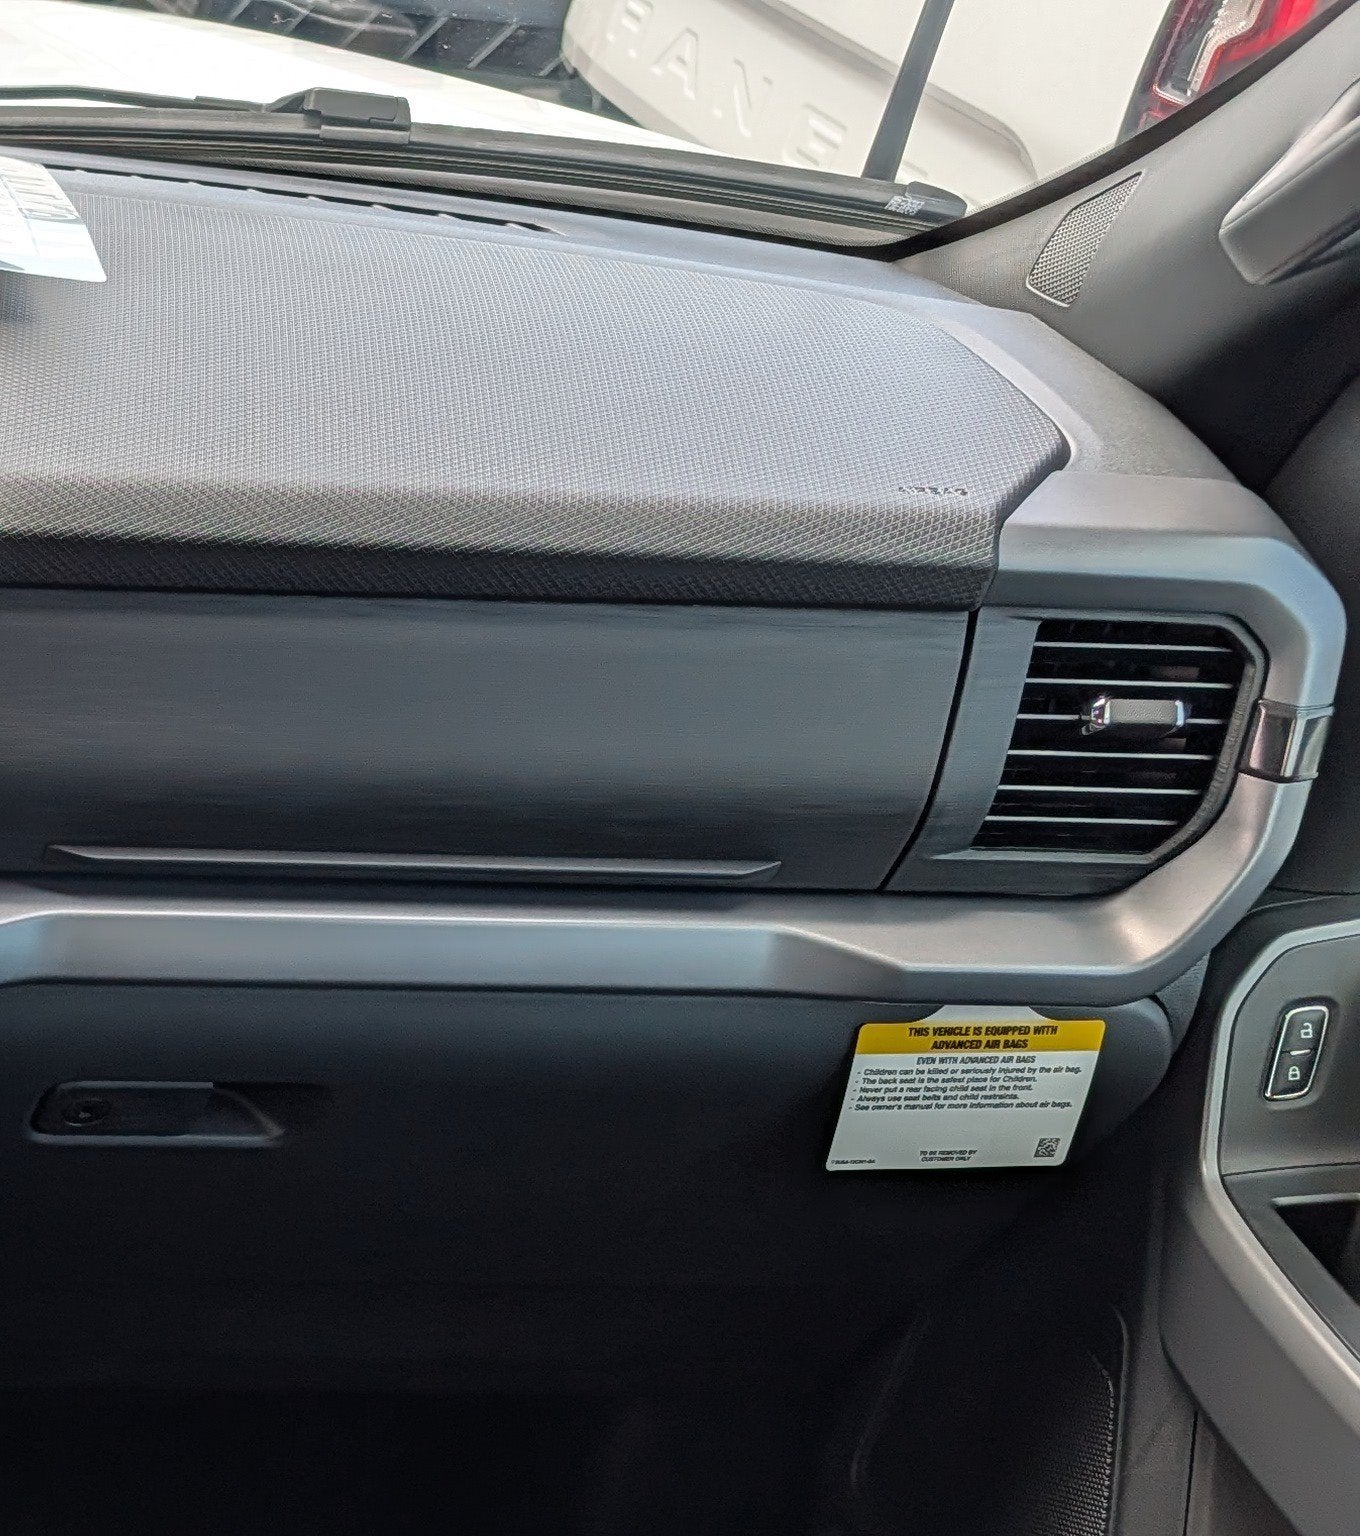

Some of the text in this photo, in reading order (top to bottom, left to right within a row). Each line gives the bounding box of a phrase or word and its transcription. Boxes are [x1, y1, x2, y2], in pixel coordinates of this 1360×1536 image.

[908, 1025, 1058, 1037] THIS VEHICLE IS EQUIPPED WITH
[930, 1039, 1029, 1050] ADVANCED AIR BAGS
[916, 1055, 1037, 1065] EVEN WITH ADVANCED AIR BAGS
[864, 1068, 897, 1076] Children
[961, 1067, 997, 1075] seriously
[997, 1067, 1025, 1075] injured
[1027, 1066, 1037, 1075] by
[1065, 1066, 1081, 1074] bag.
[883, 1086, 898, 1094] put
[934, 1102, 945, 1110] for
